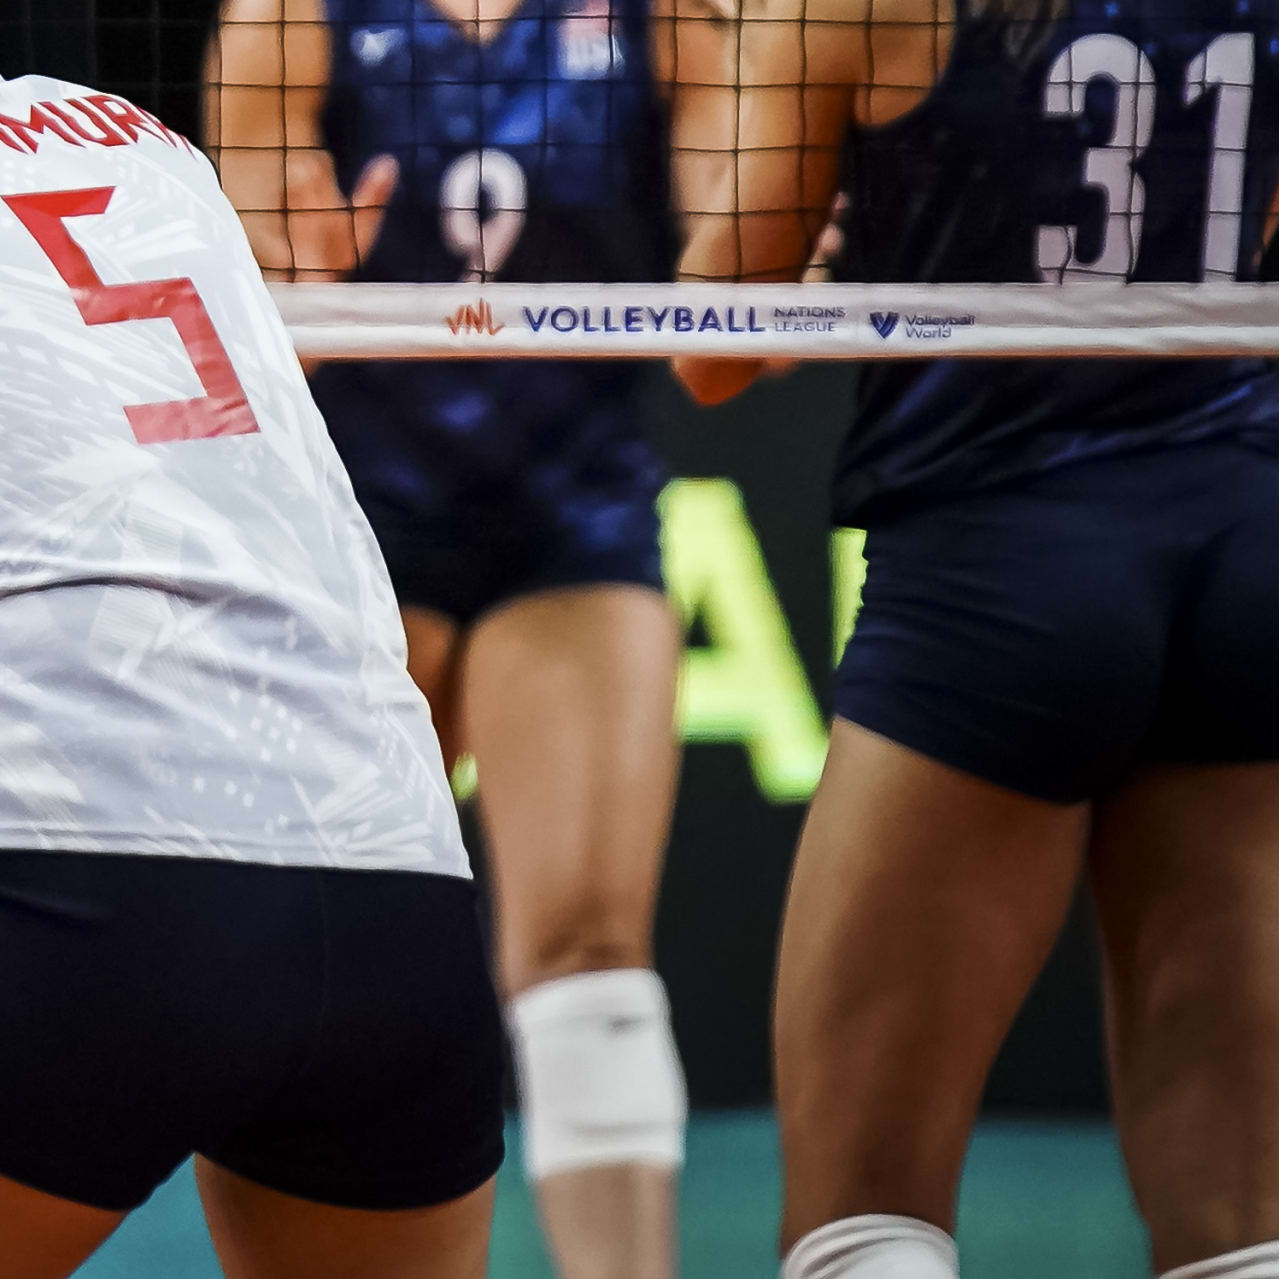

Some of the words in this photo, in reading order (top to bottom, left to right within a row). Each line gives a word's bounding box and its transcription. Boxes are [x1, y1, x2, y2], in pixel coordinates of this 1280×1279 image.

[1035, 32, 1255, 284] 31
[0, 185, 261, 444] 5
[523, 306, 766, 333] VOLLEYBALL
[773, 306, 847, 318] NATIONS
[774, 321, 837, 333] LEAGUE
[906, 327, 952, 338] World
